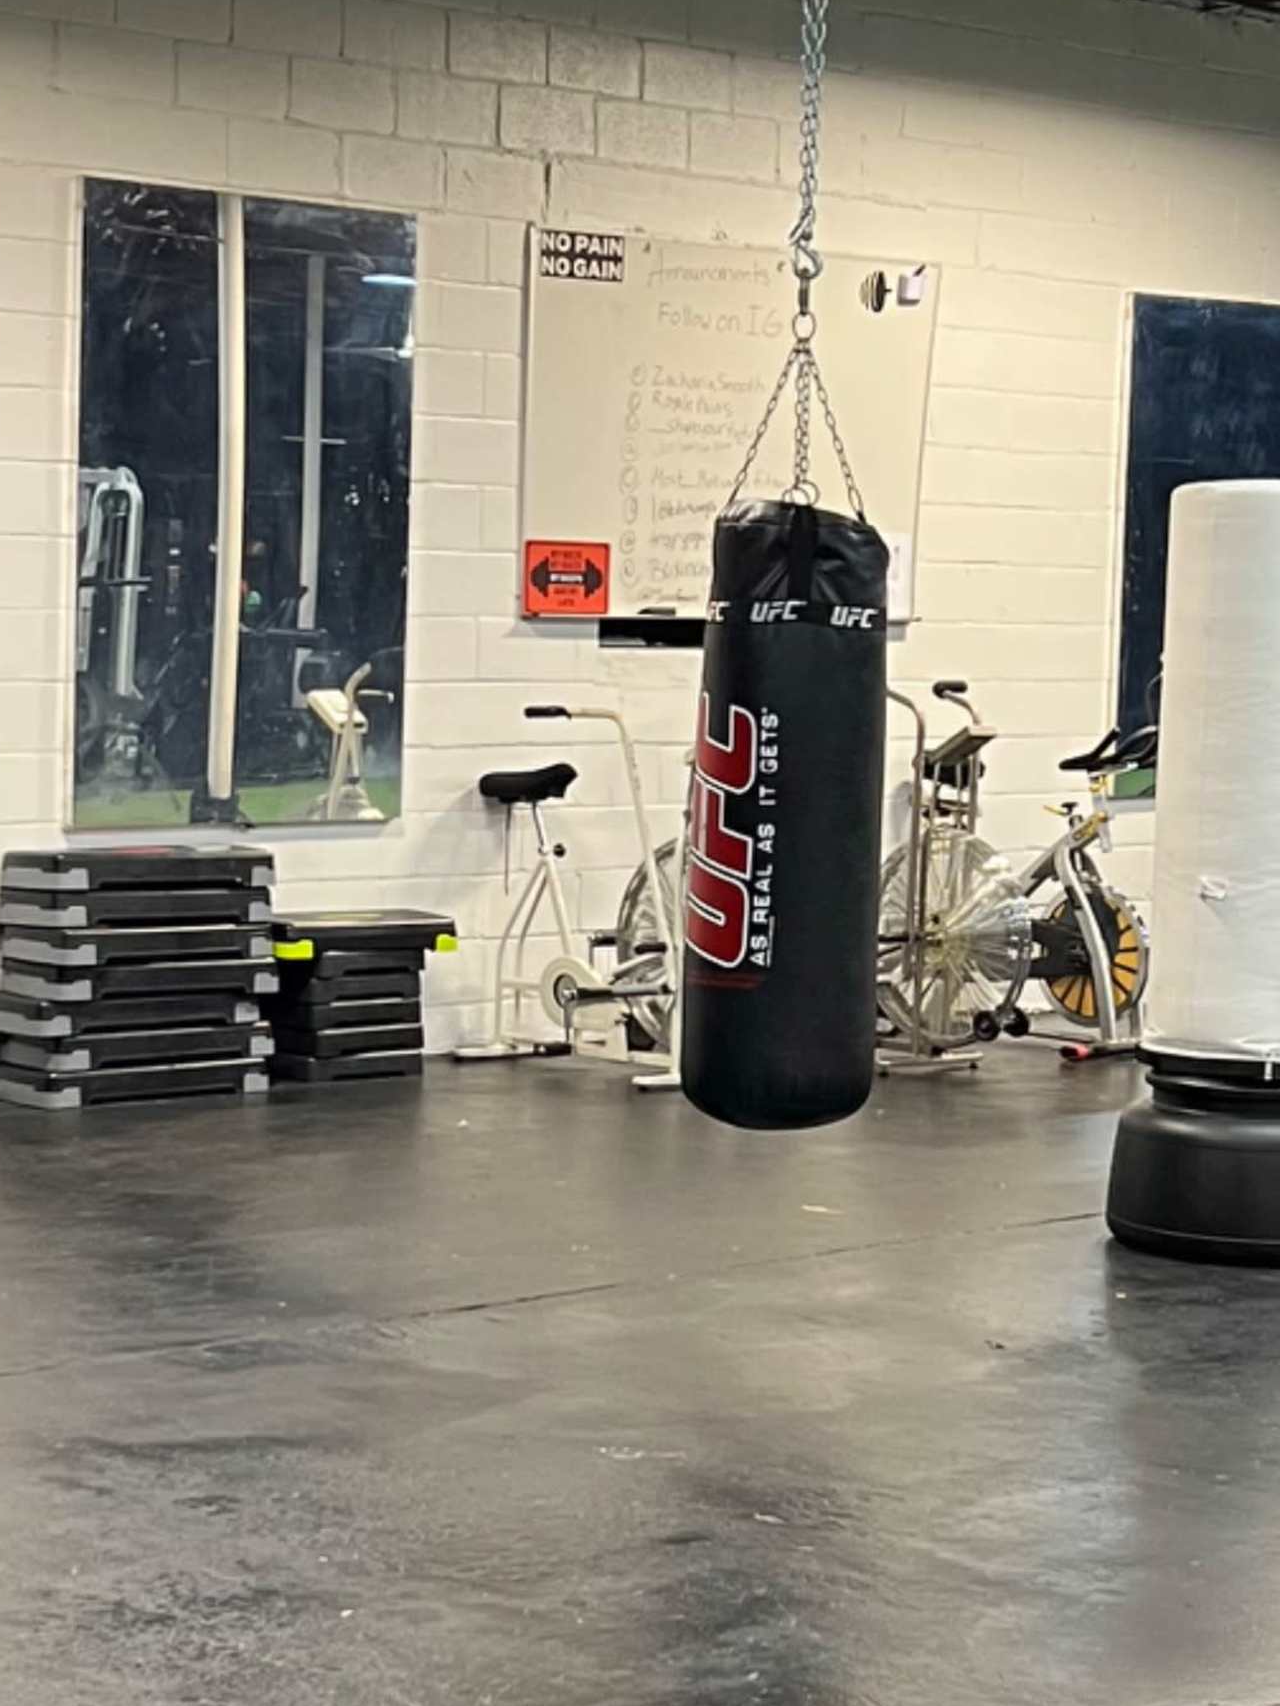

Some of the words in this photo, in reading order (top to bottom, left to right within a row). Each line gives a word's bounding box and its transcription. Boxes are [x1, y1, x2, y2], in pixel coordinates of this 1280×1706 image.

[542, 232, 571, 252] NO
[574, 235, 624, 257] PAIN
[541, 256, 570, 276] NO
[573, 258, 623, 281] GAIN
[716, 313, 742, 334] on
[749, 600, 808, 624] UFC
[829, 604, 880, 629] UFC
[759, 711, 780, 774] GETS
[759, 786, 777, 807] IT
[685, 690, 758, 969] UFC
[758, 823, 776, 855] AS
[751, 863, 773, 925] REAL
[749, 934, 770, 967] AS
